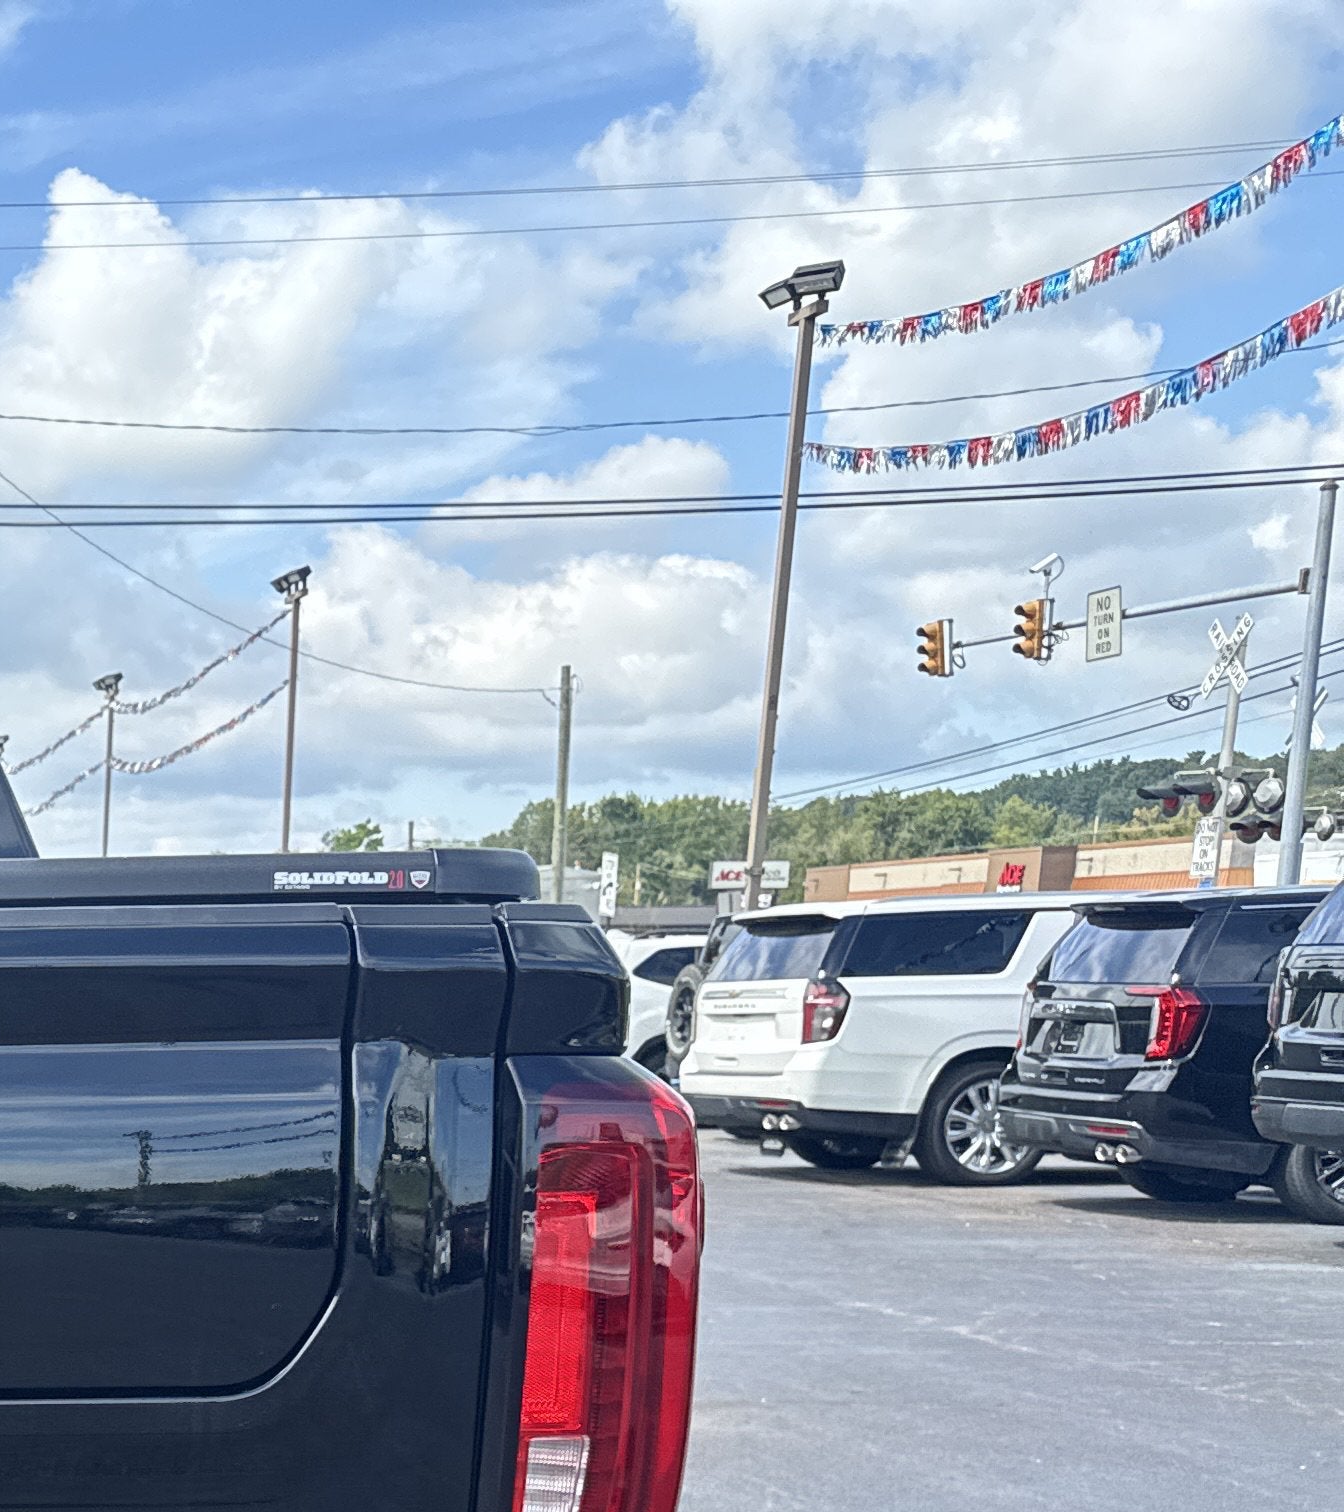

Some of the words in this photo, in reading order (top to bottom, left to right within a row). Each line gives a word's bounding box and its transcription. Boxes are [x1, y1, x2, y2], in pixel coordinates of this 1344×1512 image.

[1096, 595, 1111, 613] NO
[1093, 612, 1115, 627] TURN
[1097, 628, 1110, 640] ON
[1095, 640, 1111, 654] RED
[1192, 861, 1214, 872] TRACKS
[273, 871, 389, 885] SOLIDFOLD
[715, 869, 745, 881] ACE
[998, 862, 1026, 886] ACE
